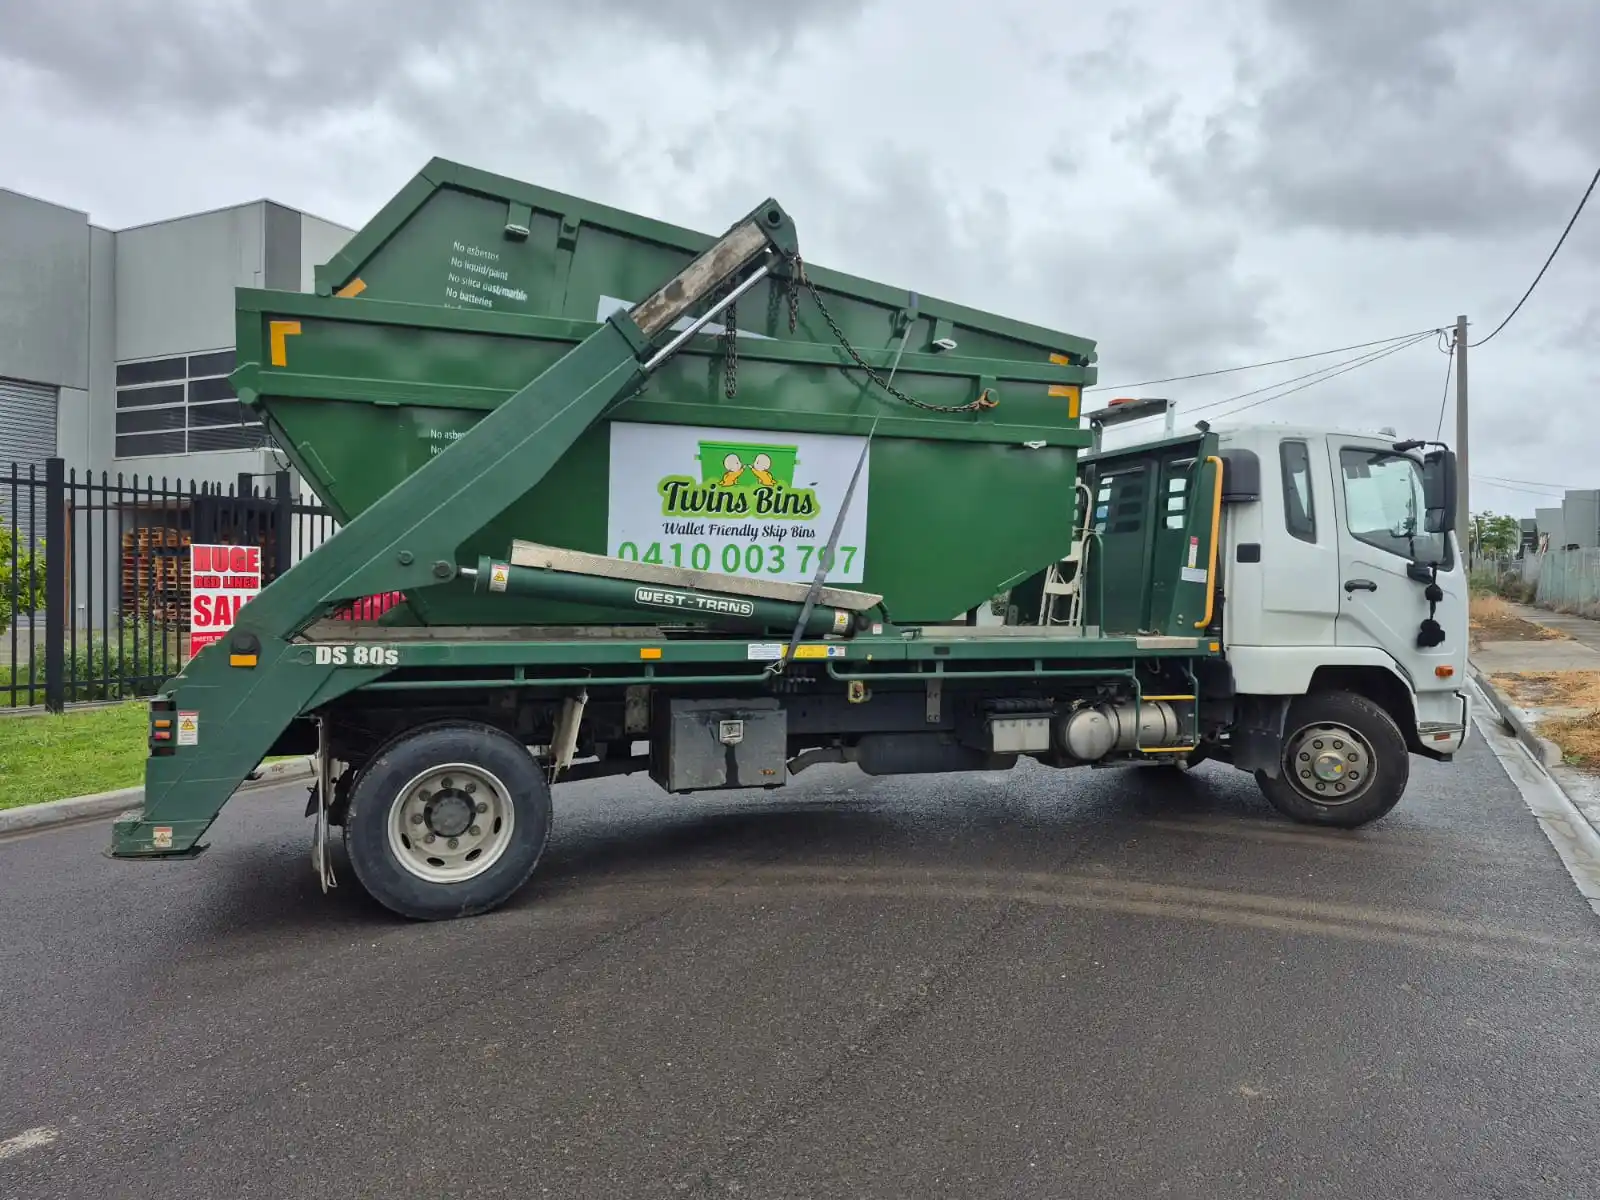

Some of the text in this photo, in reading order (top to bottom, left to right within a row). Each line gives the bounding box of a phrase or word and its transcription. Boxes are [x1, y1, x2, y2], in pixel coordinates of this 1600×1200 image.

[453, 241, 500, 261] No asbestos
[448, 272, 460, 283] No
[450, 256, 509, 280] No liquid/paint
[445, 287, 493, 308] No batteries
[430, 429, 443, 439] No
[663, 481, 815, 515] Twins Bins
[662, 522, 816, 542] Wallet Friendly Skip Bins
[193, 546, 260, 573] HUGE
[618, 541, 711, 571] 0410
[721, 543, 785, 574] 003
[194, 575, 259, 589] BED LINEN
[193, 595, 256, 627] SAL
[315, 646, 399, 665] DS 80s
